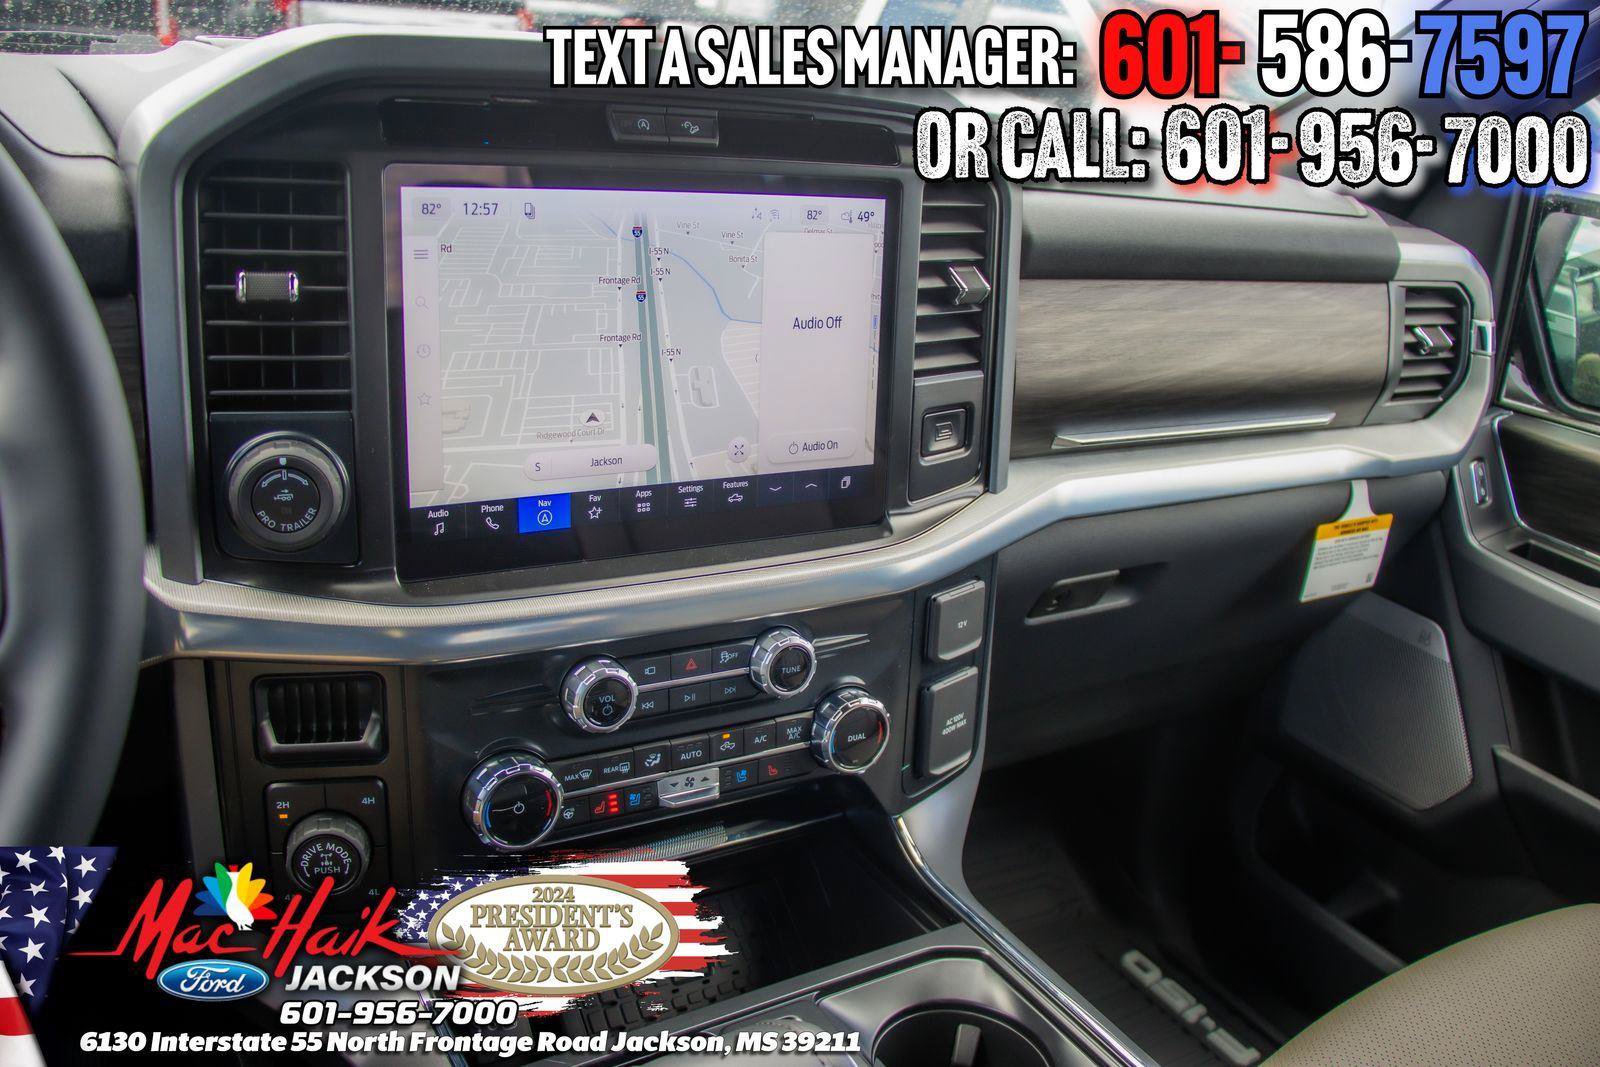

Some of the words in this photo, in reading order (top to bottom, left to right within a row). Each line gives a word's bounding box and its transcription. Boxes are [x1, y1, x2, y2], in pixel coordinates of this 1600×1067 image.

[421, 203, 442, 215] 82°
[463, 202, 499, 216] 12:57
[857, 211, 875, 222] 49°
[676, 220, 690, 229] Vine
[691, 221, 700, 230] St
[721, 230, 735, 239] Vine
[736, 231, 744, 239] St
[440, 244, 452, 253] Rd
[649, 247, 664, 255] I-55
[664, 247, 670, 255] N
[729, 254, 748, 263] Bonita
[749, 254, 758, 263] St
[650, 268, 665, 276] I-55
[665, 267, 671, 275] N
[598, 276, 629, 286] Frontage
[630, 276, 641, 284] Rd
[637, 293, 646, 301] 55
[792, 317, 824, 330] Audio
[826, 316, 842, 329] Off
[600, 334, 631, 343] Frontage
[631, 333, 642, 341] Rd
[661, 348, 676, 356] I-55
[676, 347, 681, 355] N
[536, 429, 576, 440] Ridgewood
[577, 429, 597, 438] Court
[802, 442, 825, 453] Audio
[826, 440, 839, 450] On
[535, 462, 541, 472] S
[590, 456, 623, 468] Jackson
[678, 484, 704, 495] Settings
[723, 480, 749, 490] Features
[589, 494, 602, 502] Fav
[636, 489, 652, 499] Apps
[481, 504, 504, 513] Phone
[538, 499, 552, 508] Nav
[427, 509, 449, 519] Audio
[257, 510, 277, 529] PRO
[280, 507, 318, 532] TRAILER
[782, 665, 801, 674] TUNE
[599, 694, 616, 703] VOL
[956, 719, 968, 729] MAX
[786, 725, 802, 734] MAX
[754, 734, 768, 744] A/C
[788, 732, 801, 740] A/C
[847, 732, 867, 743] DUAL
[680, 749, 702, 761] AUTO
[603, 765, 619, 774] REAR
[564, 772, 580, 782] MAX
[275, 801, 290, 809] 2H
[361, 797, 375, 805] 4H
[300, 843, 324, 868] DRIVE
[326, 842, 352, 865] MODE
[314, 866, 341, 875] PUSH
